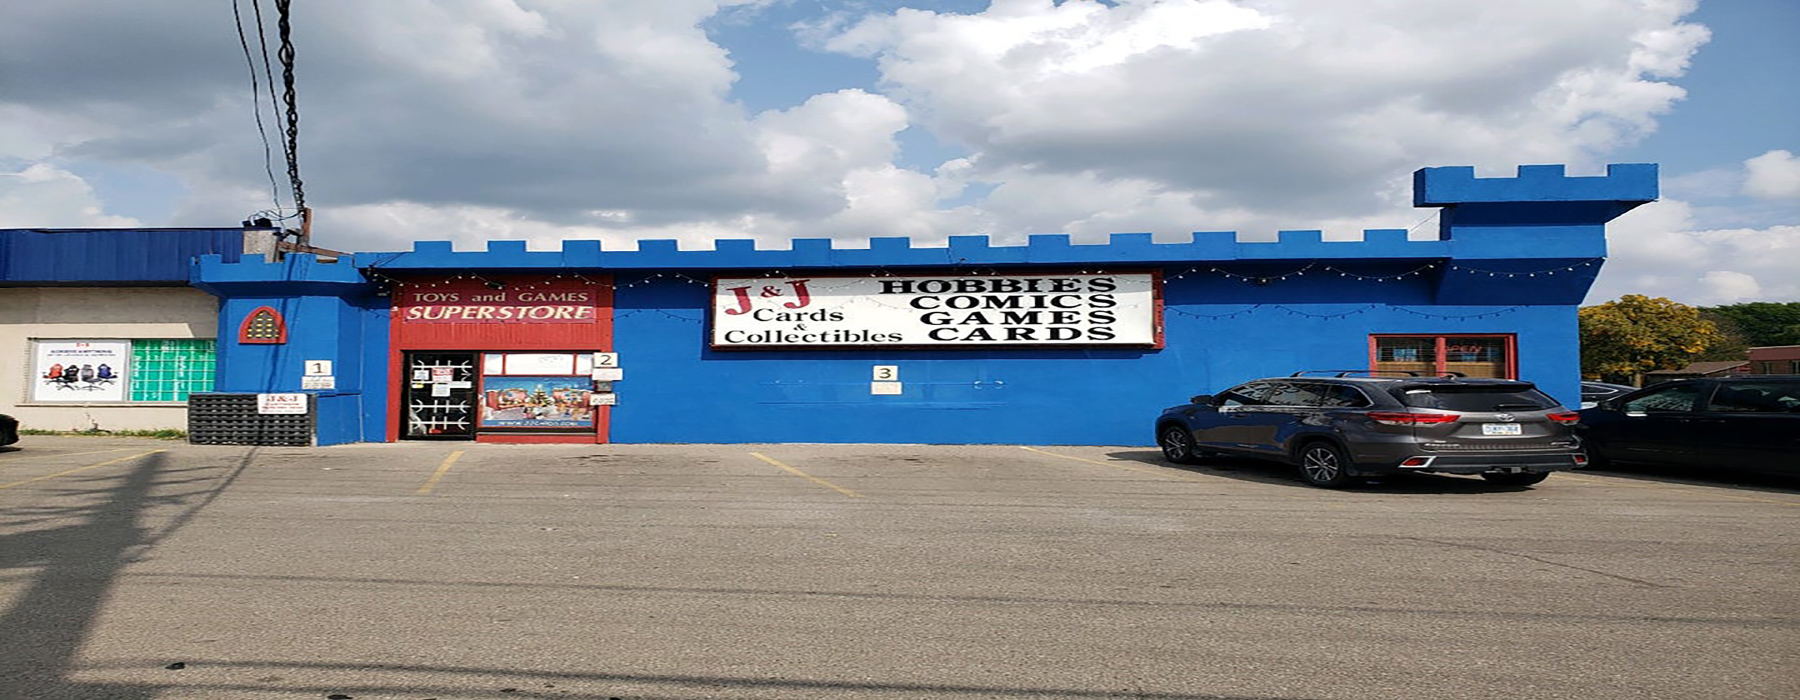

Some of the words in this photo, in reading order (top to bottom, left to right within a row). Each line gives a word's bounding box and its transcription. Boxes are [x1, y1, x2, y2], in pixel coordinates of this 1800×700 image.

[877, 277, 1117, 295] HOBBIES
[413, 292, 460, 303] TOYS
[471, 291, 506, 303] and
[517, 292, 589, 303] GAMES
[909, 294, 1117, 310] COMICS
[406, 305, 595, 320] SUPERSTORE
[753, 308, 845, 322] Cards
[919, 310, 1117, 326] GAMES
[792, 322, 808, 332] &
[928, 326, 1116, 342] CARDS
[723, 329, 904, 344] Collectibles
[600, 354, 612, 366] 2
[313, 363, 325, 374] 1
[879, 367, 892, 379] 3
